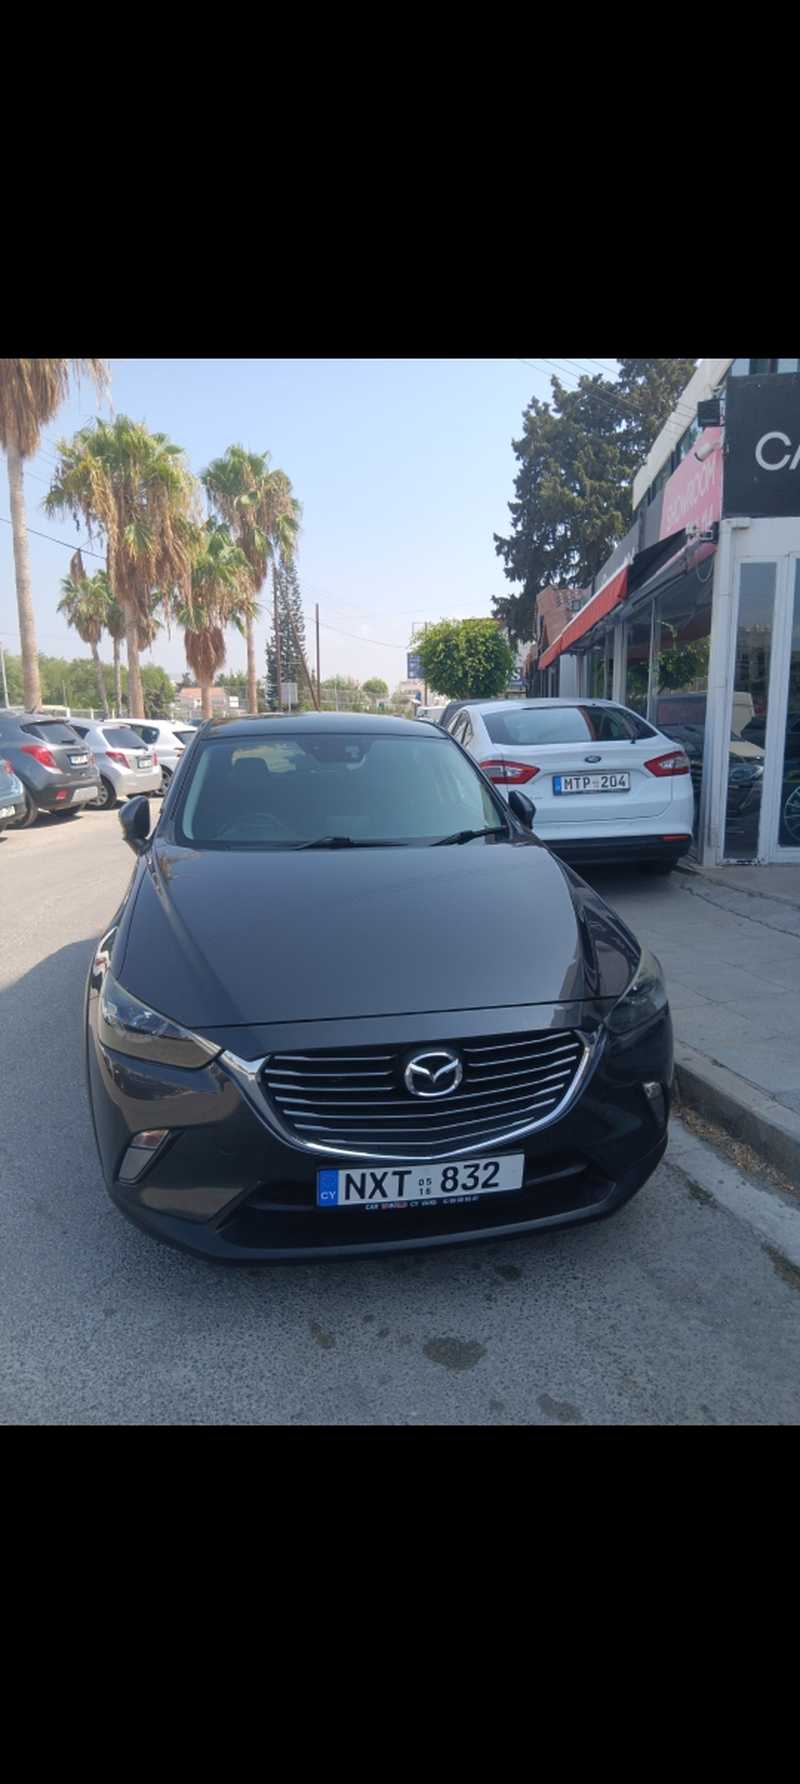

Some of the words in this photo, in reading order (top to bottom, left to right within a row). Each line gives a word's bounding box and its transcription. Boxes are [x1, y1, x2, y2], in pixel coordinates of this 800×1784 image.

[564, 776, 590, 790] MTP
[601, 775, 626, 788] 204
[345, 1170, 412, 1200] NXT
[441, 1161, 500, 1193] 832
[320, 1191, 336, 1200] CY
